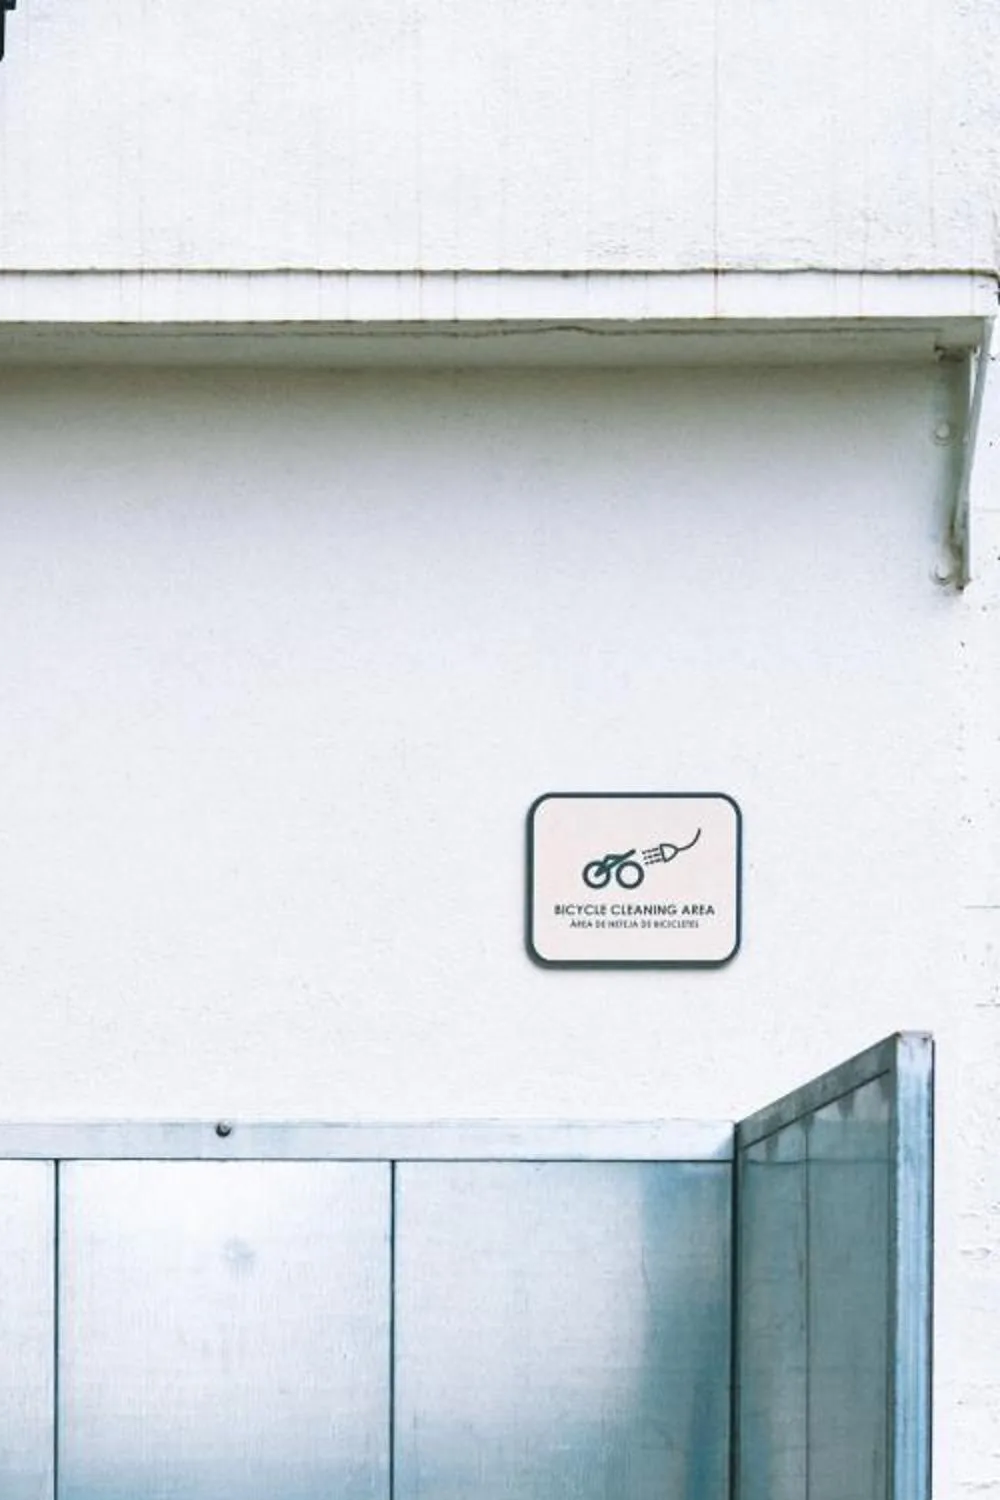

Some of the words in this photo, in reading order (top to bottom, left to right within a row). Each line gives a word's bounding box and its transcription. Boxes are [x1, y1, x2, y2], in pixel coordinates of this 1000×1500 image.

[554, 904, 607, 915] BICYCLE
[610, 904, 677, 915] CLEANING
[681, 904, 715, 915] AREA
